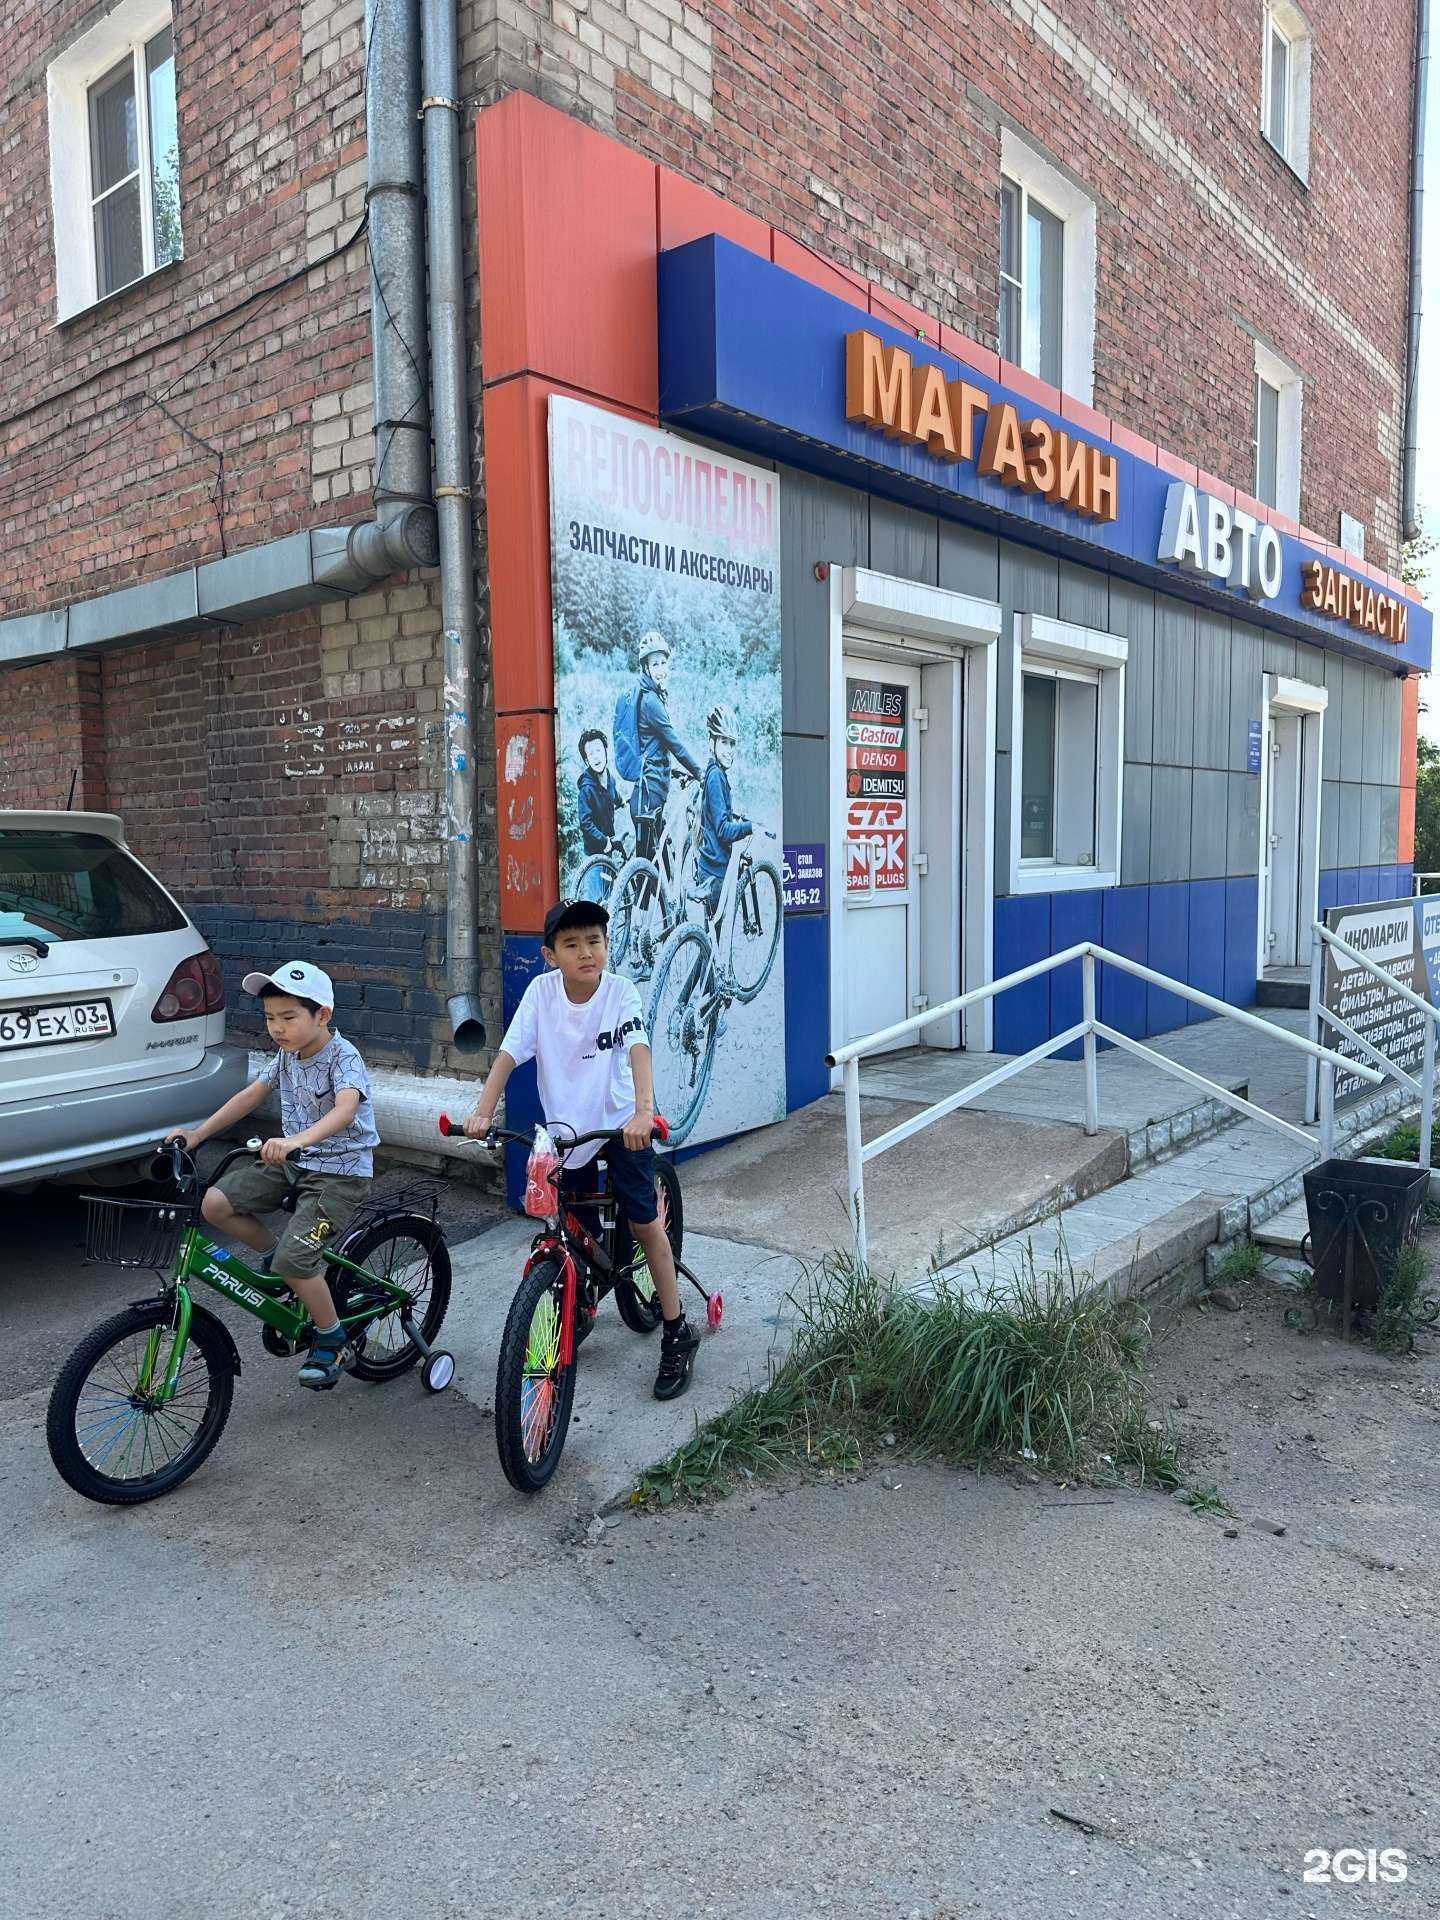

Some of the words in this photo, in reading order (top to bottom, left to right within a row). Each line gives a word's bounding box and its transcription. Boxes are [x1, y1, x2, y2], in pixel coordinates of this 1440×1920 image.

[566, 415, 773, 551] ВЕЛОСИПЕДЫ
[846, 329, 1118, 524] МАГАЗИН
[1158, 482, 1283, 600] АВТО
[1303, 560, 1409, 643] ЗАПЧАСТИ
[569, 520, 661, 570] ЗАПЧАСТИ
[665, 544, 676, 573] И
[679, 549, 773, 595] АКСЕССУАРЫ
[852, 689, 902, 717] MILES
[860, 726, 900, 745] Castrol
[862, 752, 897, 767] DENSO
[863, 777, 904, 794] IDEMITSU
[847, 833, 905, 871] NGK
[846, 875, 870, 887] SPAR
[876, 873, 905, 886] PLUGS
[1344, 920, 1409, 952] ИНОМАРКИ
[75, 1006, 99, 1026] 03
[75, 1025, 95, 1033] RUS
[202, 1262, 266, 1309] PARUISI
